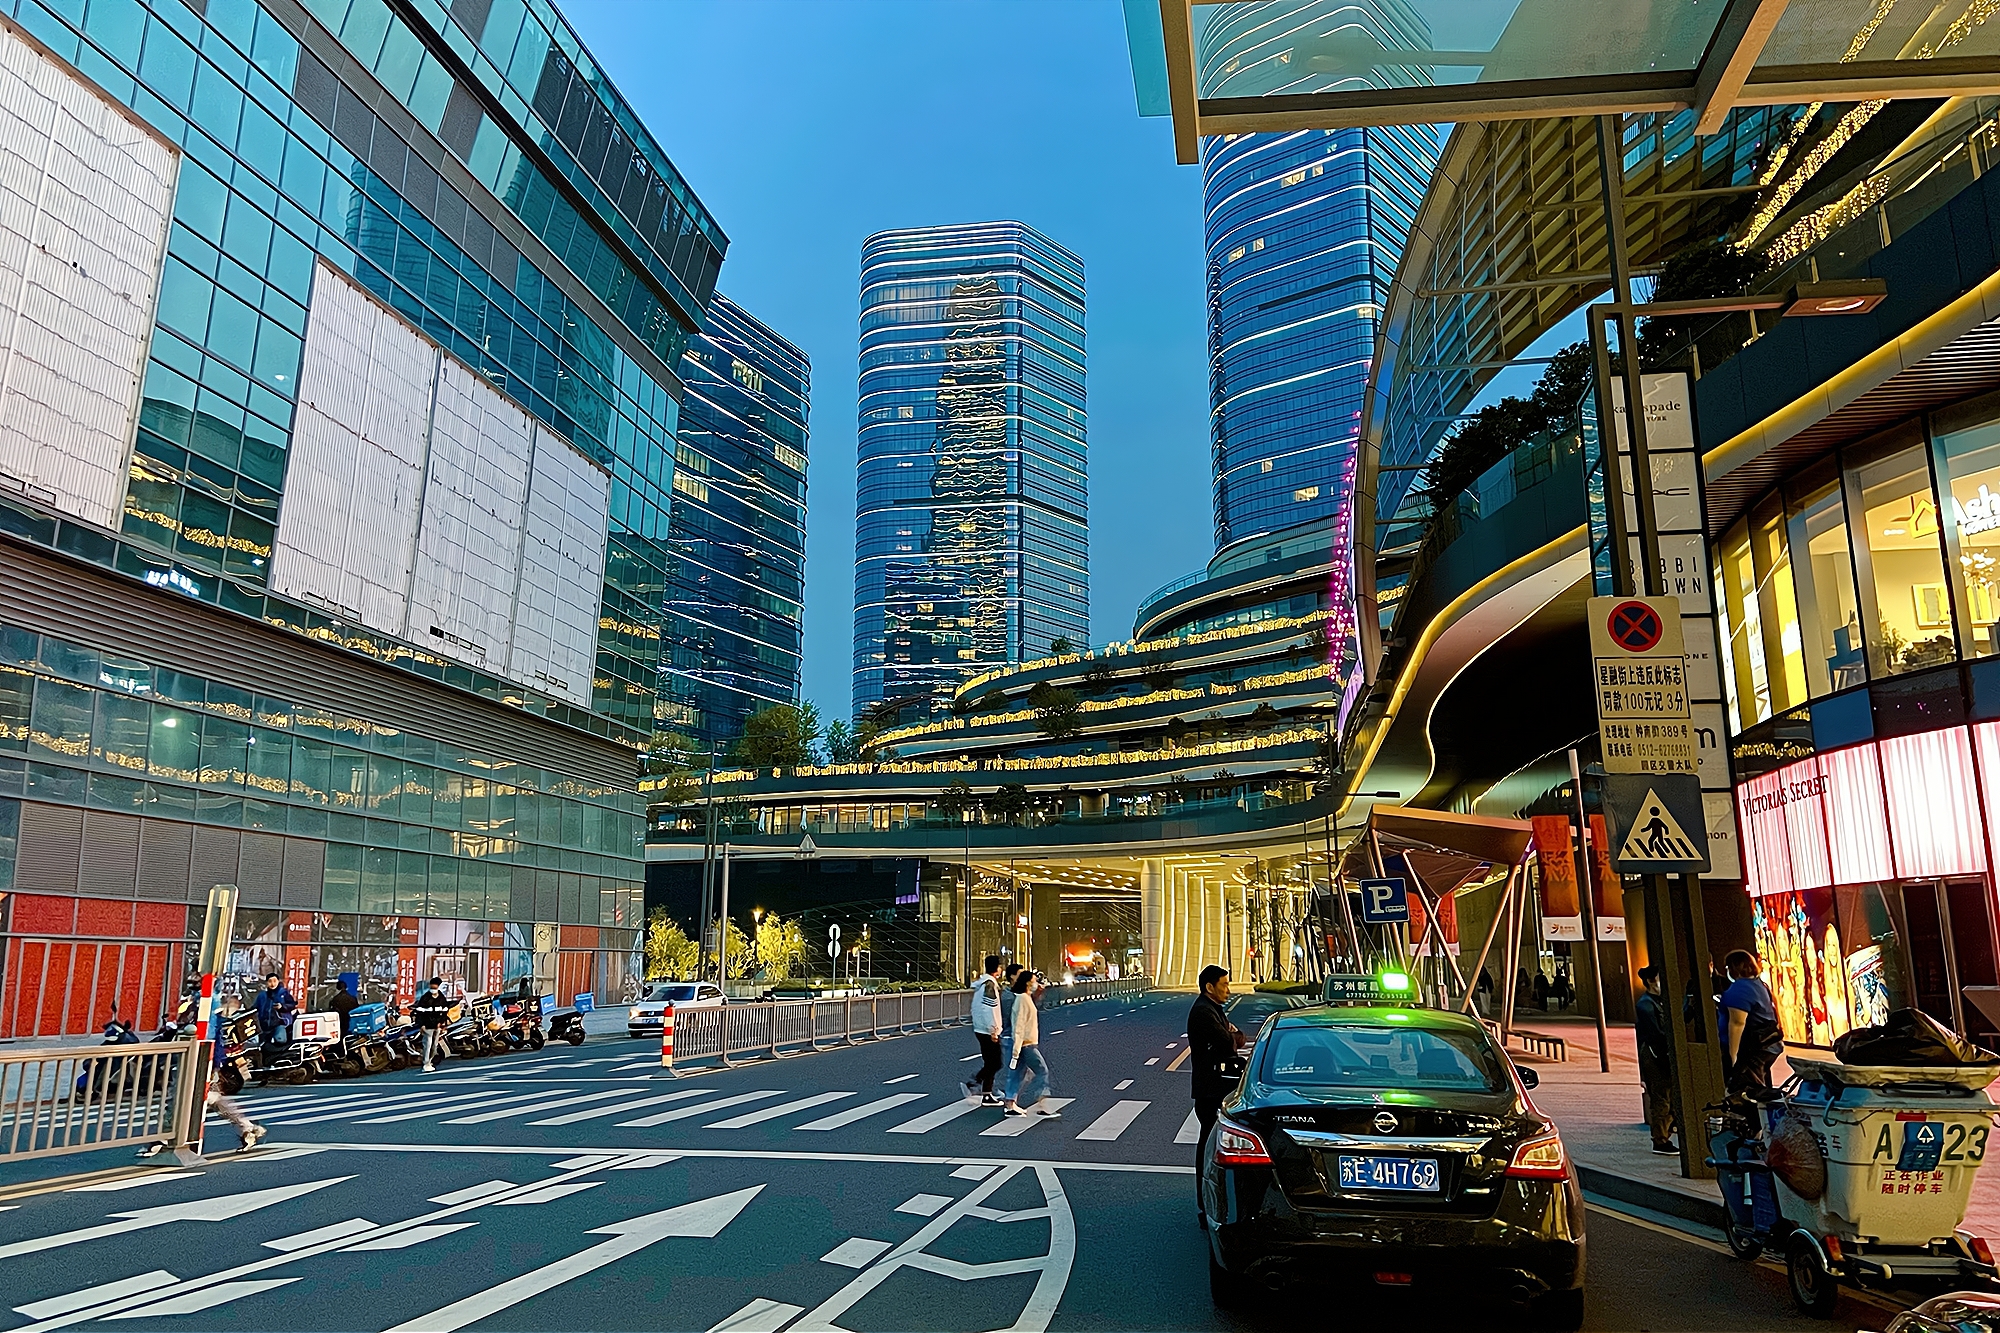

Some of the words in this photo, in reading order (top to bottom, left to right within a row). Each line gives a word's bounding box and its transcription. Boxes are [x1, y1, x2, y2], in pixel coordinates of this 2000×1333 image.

[1643, 401, 1681, 414] spade
[1599, 664, 1682, 686] 星融街上违反此标志
[1368, 885, 1393, 914] P
[1883, 1169, 1944, 1181] 正在作业
[1881, 1183, 1943, 1195] 随时停车
